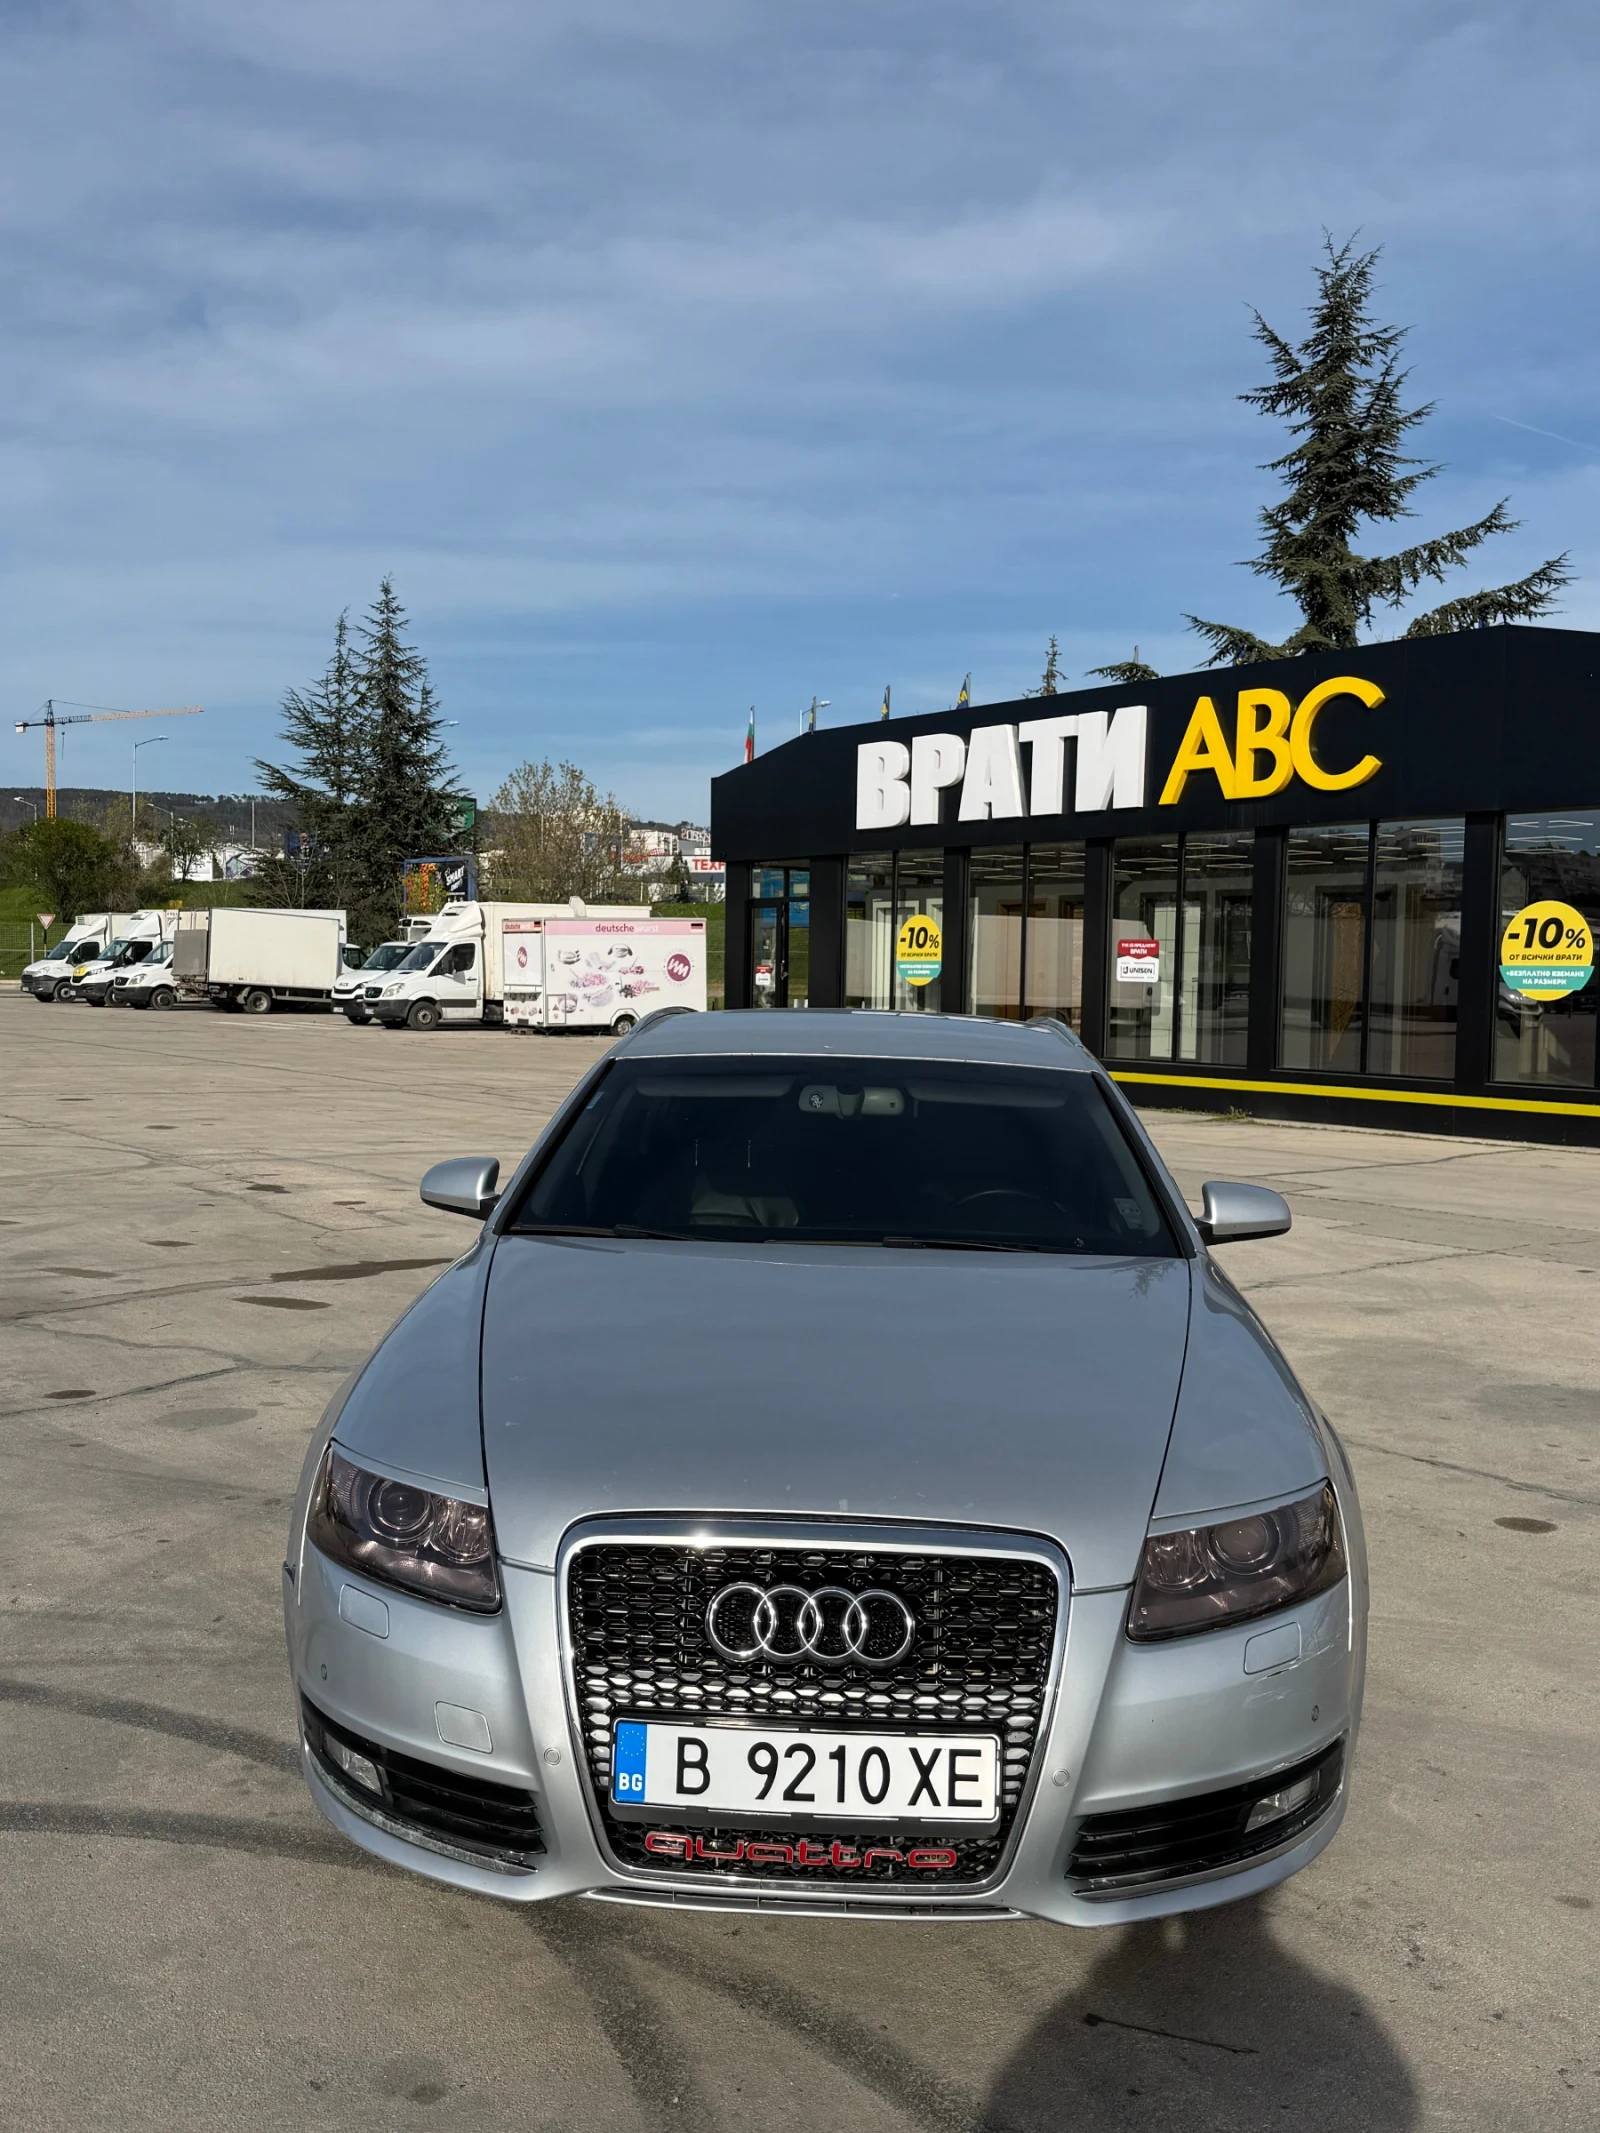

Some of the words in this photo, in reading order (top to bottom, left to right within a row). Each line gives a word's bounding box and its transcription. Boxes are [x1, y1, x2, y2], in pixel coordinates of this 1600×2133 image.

[856, 705, 1147, 831] ВРАТИ
[1158, 676, 1386, 806] ABC
[899, 926, 940, 949] -10%
[1507, 917, 1586, 949] -10%
[618, 1772, 643, 1792] BG
[675, 1736, 711, 1795] B
[747, 1741, 891, 1805] 9210
[907, 1747, 983, 1808] XE
[645, 1831, 957, 1869] quattro
